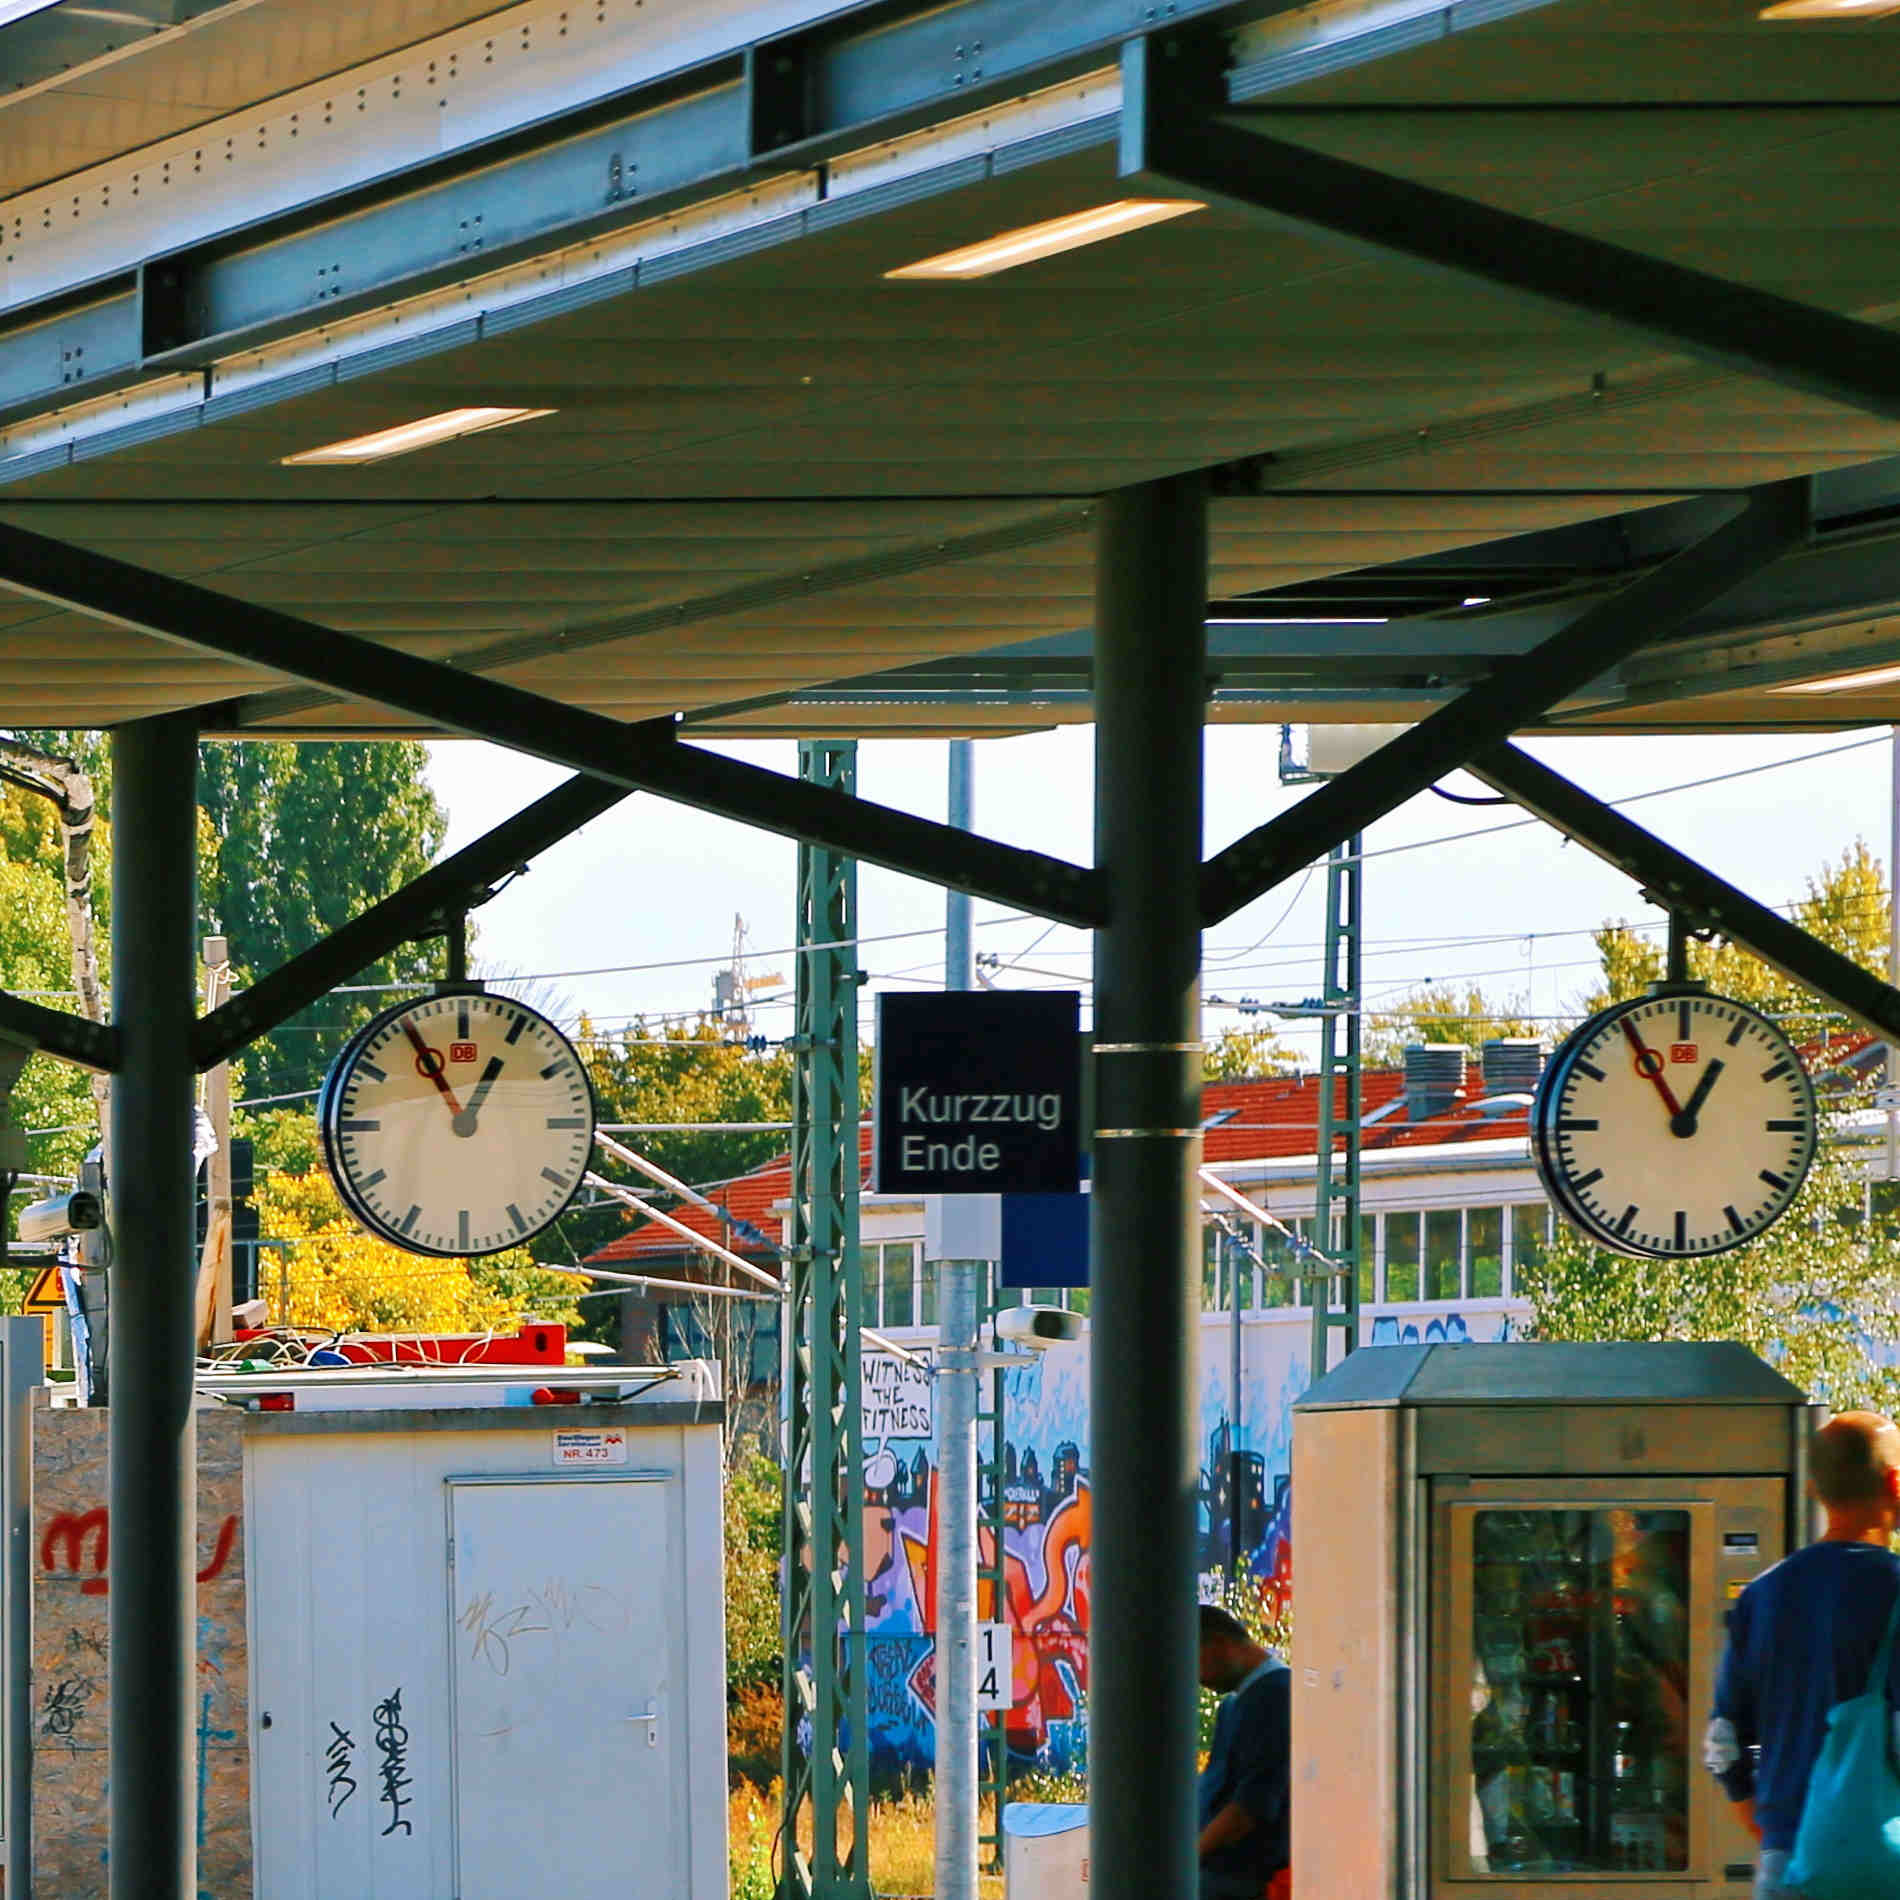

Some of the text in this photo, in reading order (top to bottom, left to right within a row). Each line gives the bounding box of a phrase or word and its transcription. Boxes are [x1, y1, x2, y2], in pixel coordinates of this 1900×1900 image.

[901, 1086, 1062, 1131] Kurzzug
[902, 1134, 1001, 1171] Ende
[872, 1386, 904, 1405] THE
[862, 1404, 930, 1433] FITNESS
[586, 1448, 609, 1458] 473
[983, 1629, 993, 1662] 1
[978, 1667, 999, 1700] 4
